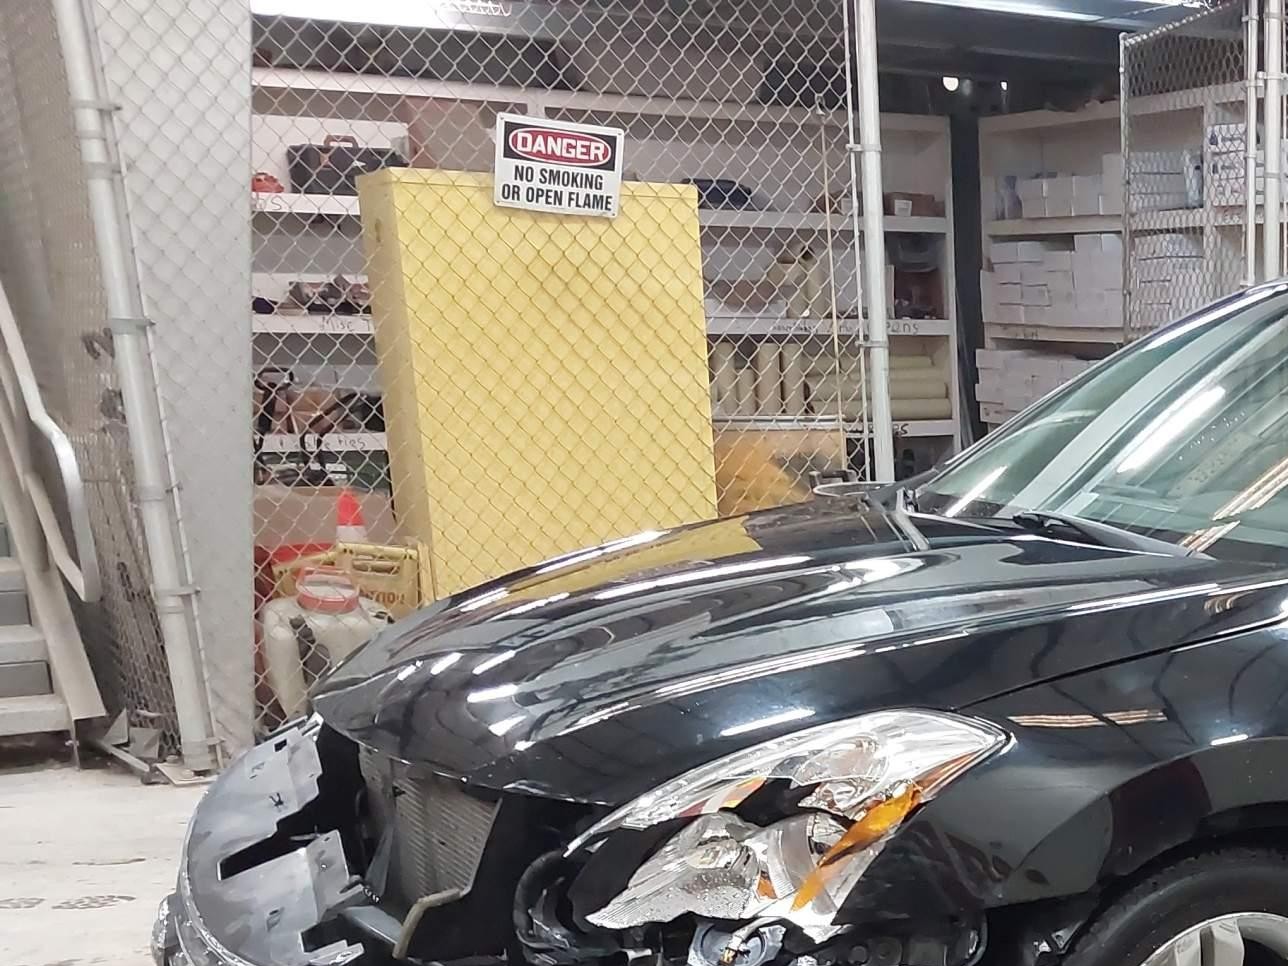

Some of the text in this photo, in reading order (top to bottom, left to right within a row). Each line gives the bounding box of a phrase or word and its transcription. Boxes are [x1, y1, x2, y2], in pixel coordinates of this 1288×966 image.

[516, 132, 605, 161] DANGER
[514, 165, 603, 190] NO SMOKING
[502, 184, 612, 211] OR OPEN FLAME
